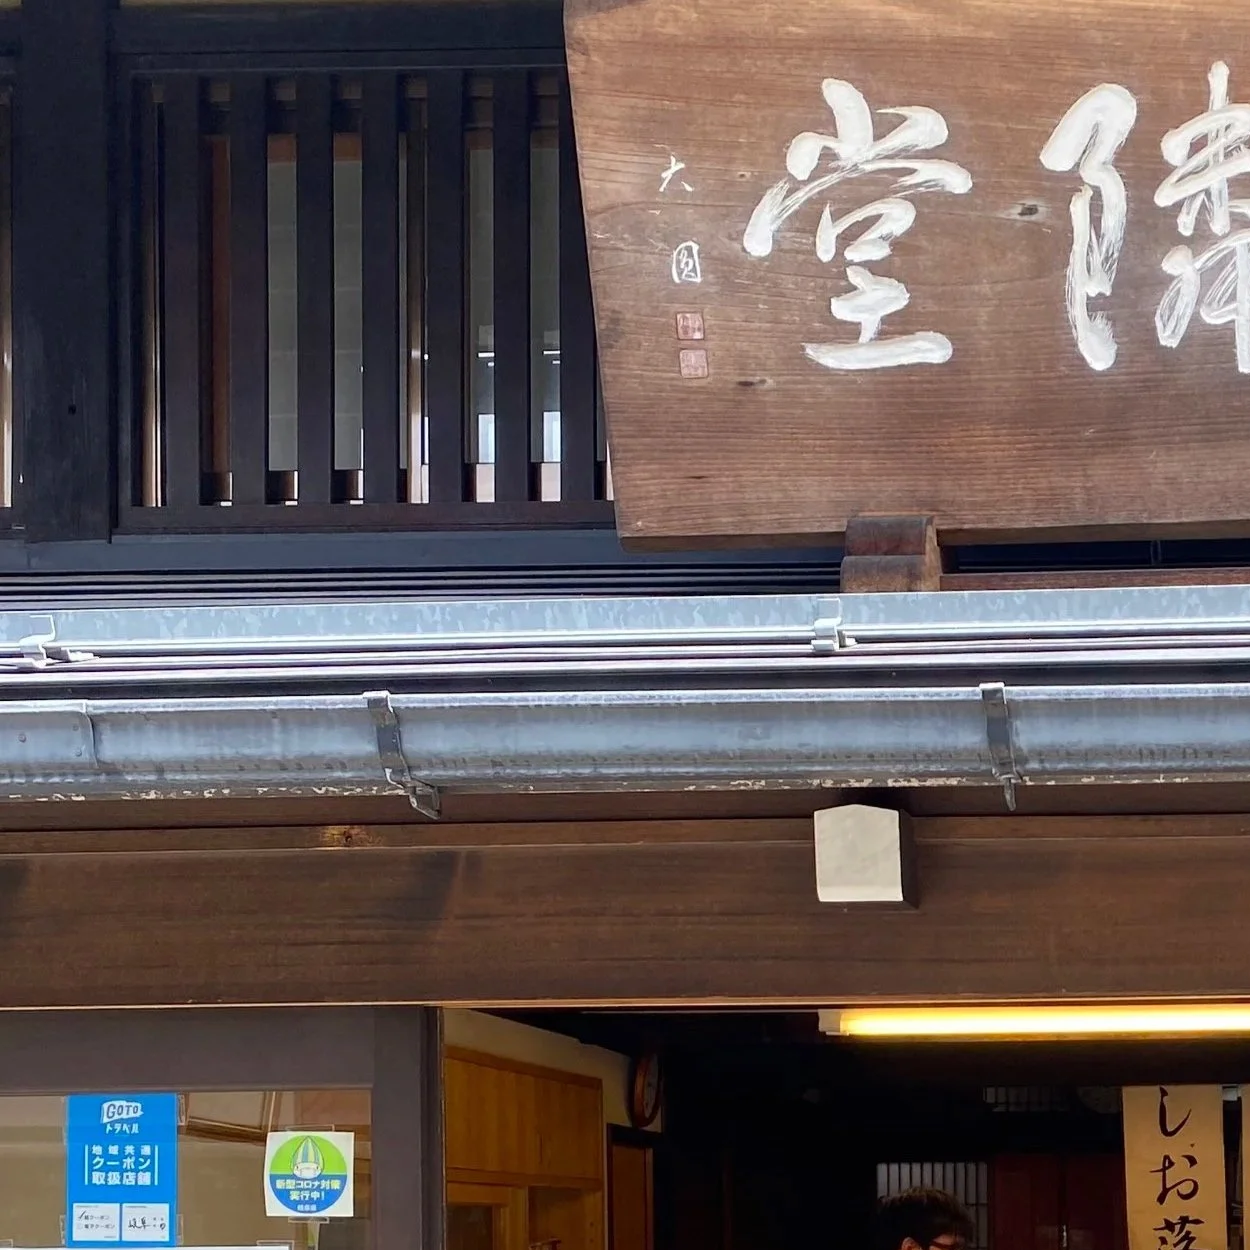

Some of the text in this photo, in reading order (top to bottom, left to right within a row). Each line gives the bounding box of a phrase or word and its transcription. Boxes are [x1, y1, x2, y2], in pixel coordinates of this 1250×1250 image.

[105, 1123, 140, 1134] トラベル
[92, 1156, 151, 1170] クーポン
[91, 1171, 151, 1186] 取扱店舗
